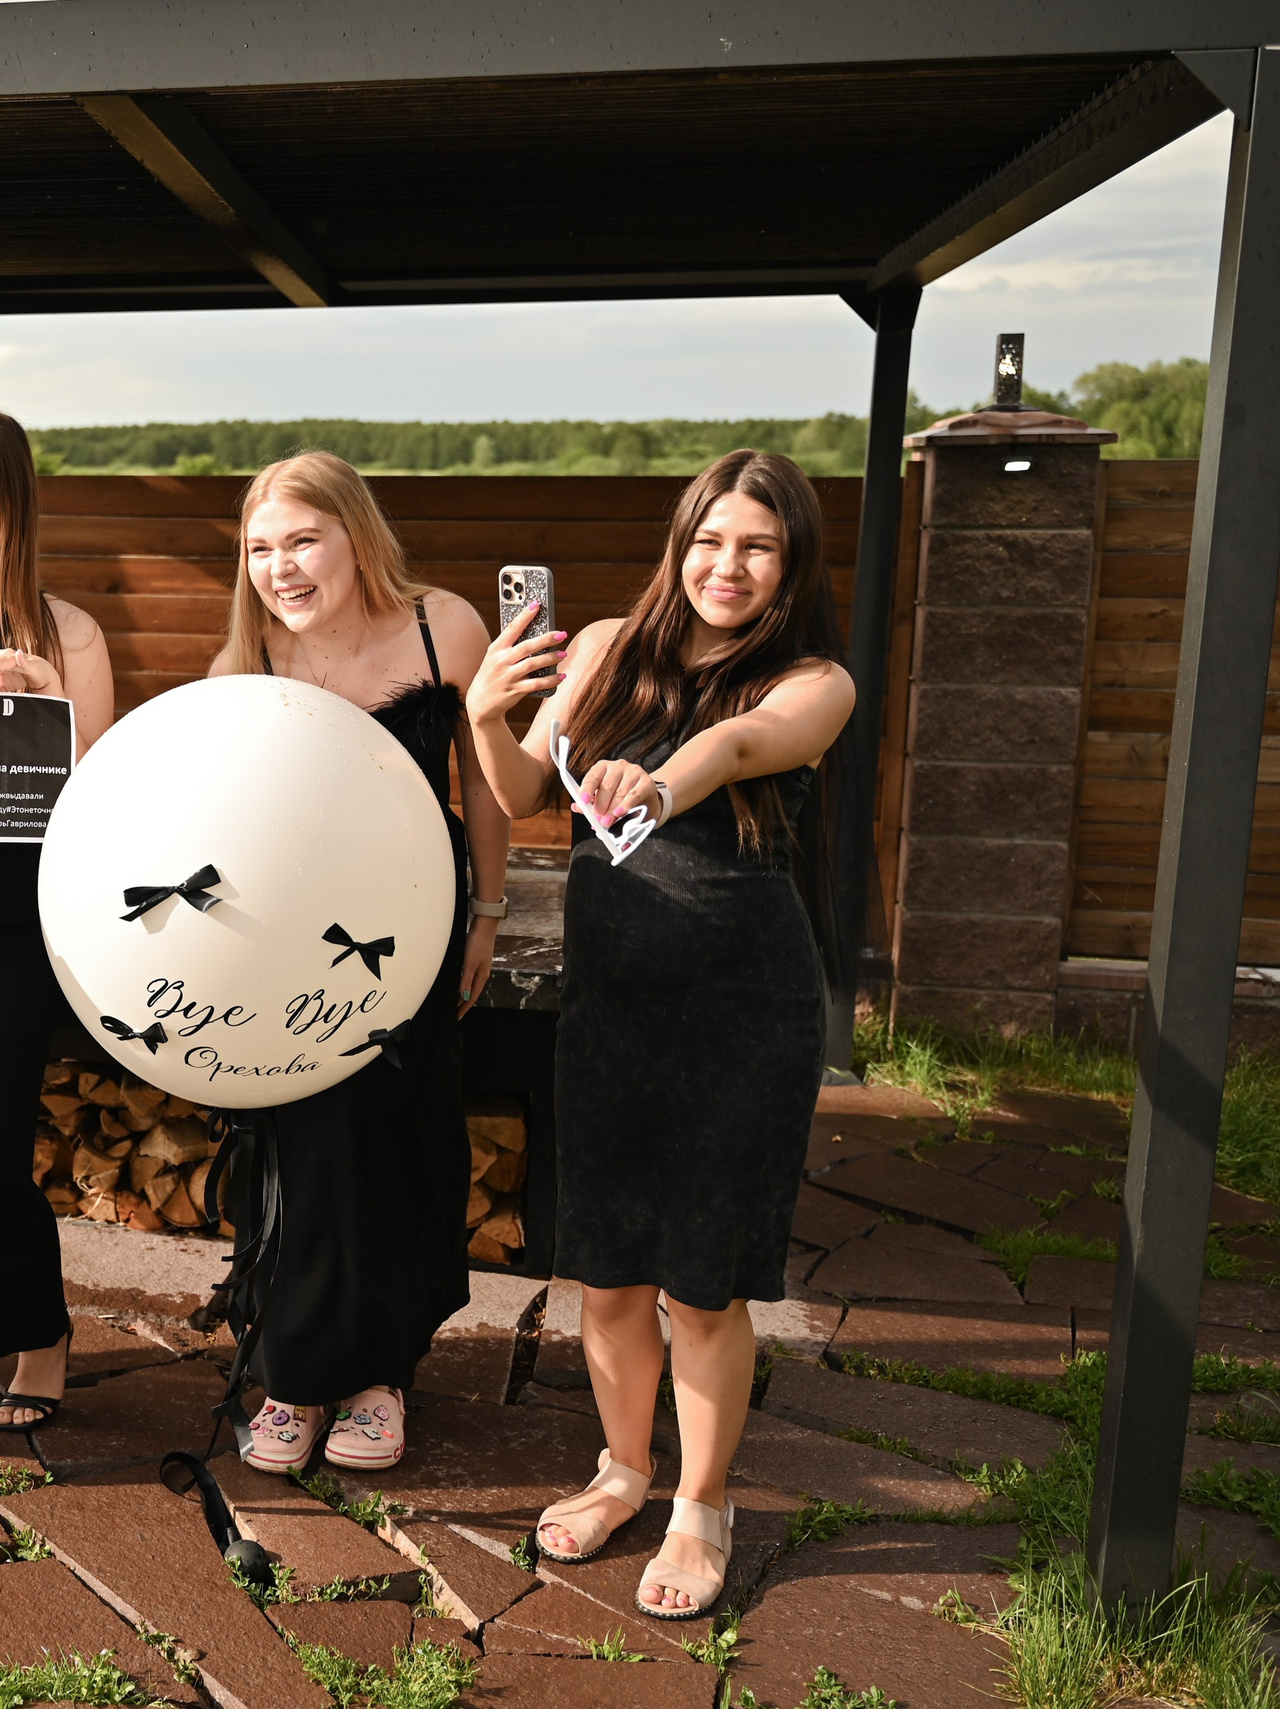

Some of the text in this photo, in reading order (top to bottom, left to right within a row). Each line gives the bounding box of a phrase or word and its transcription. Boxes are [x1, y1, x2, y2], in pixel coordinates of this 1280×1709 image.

[9, 765, 68, 775] девичнике
[146, 978, 387, 1043] Bye Bye
[184, 1046, 323, 1082] Орехова
